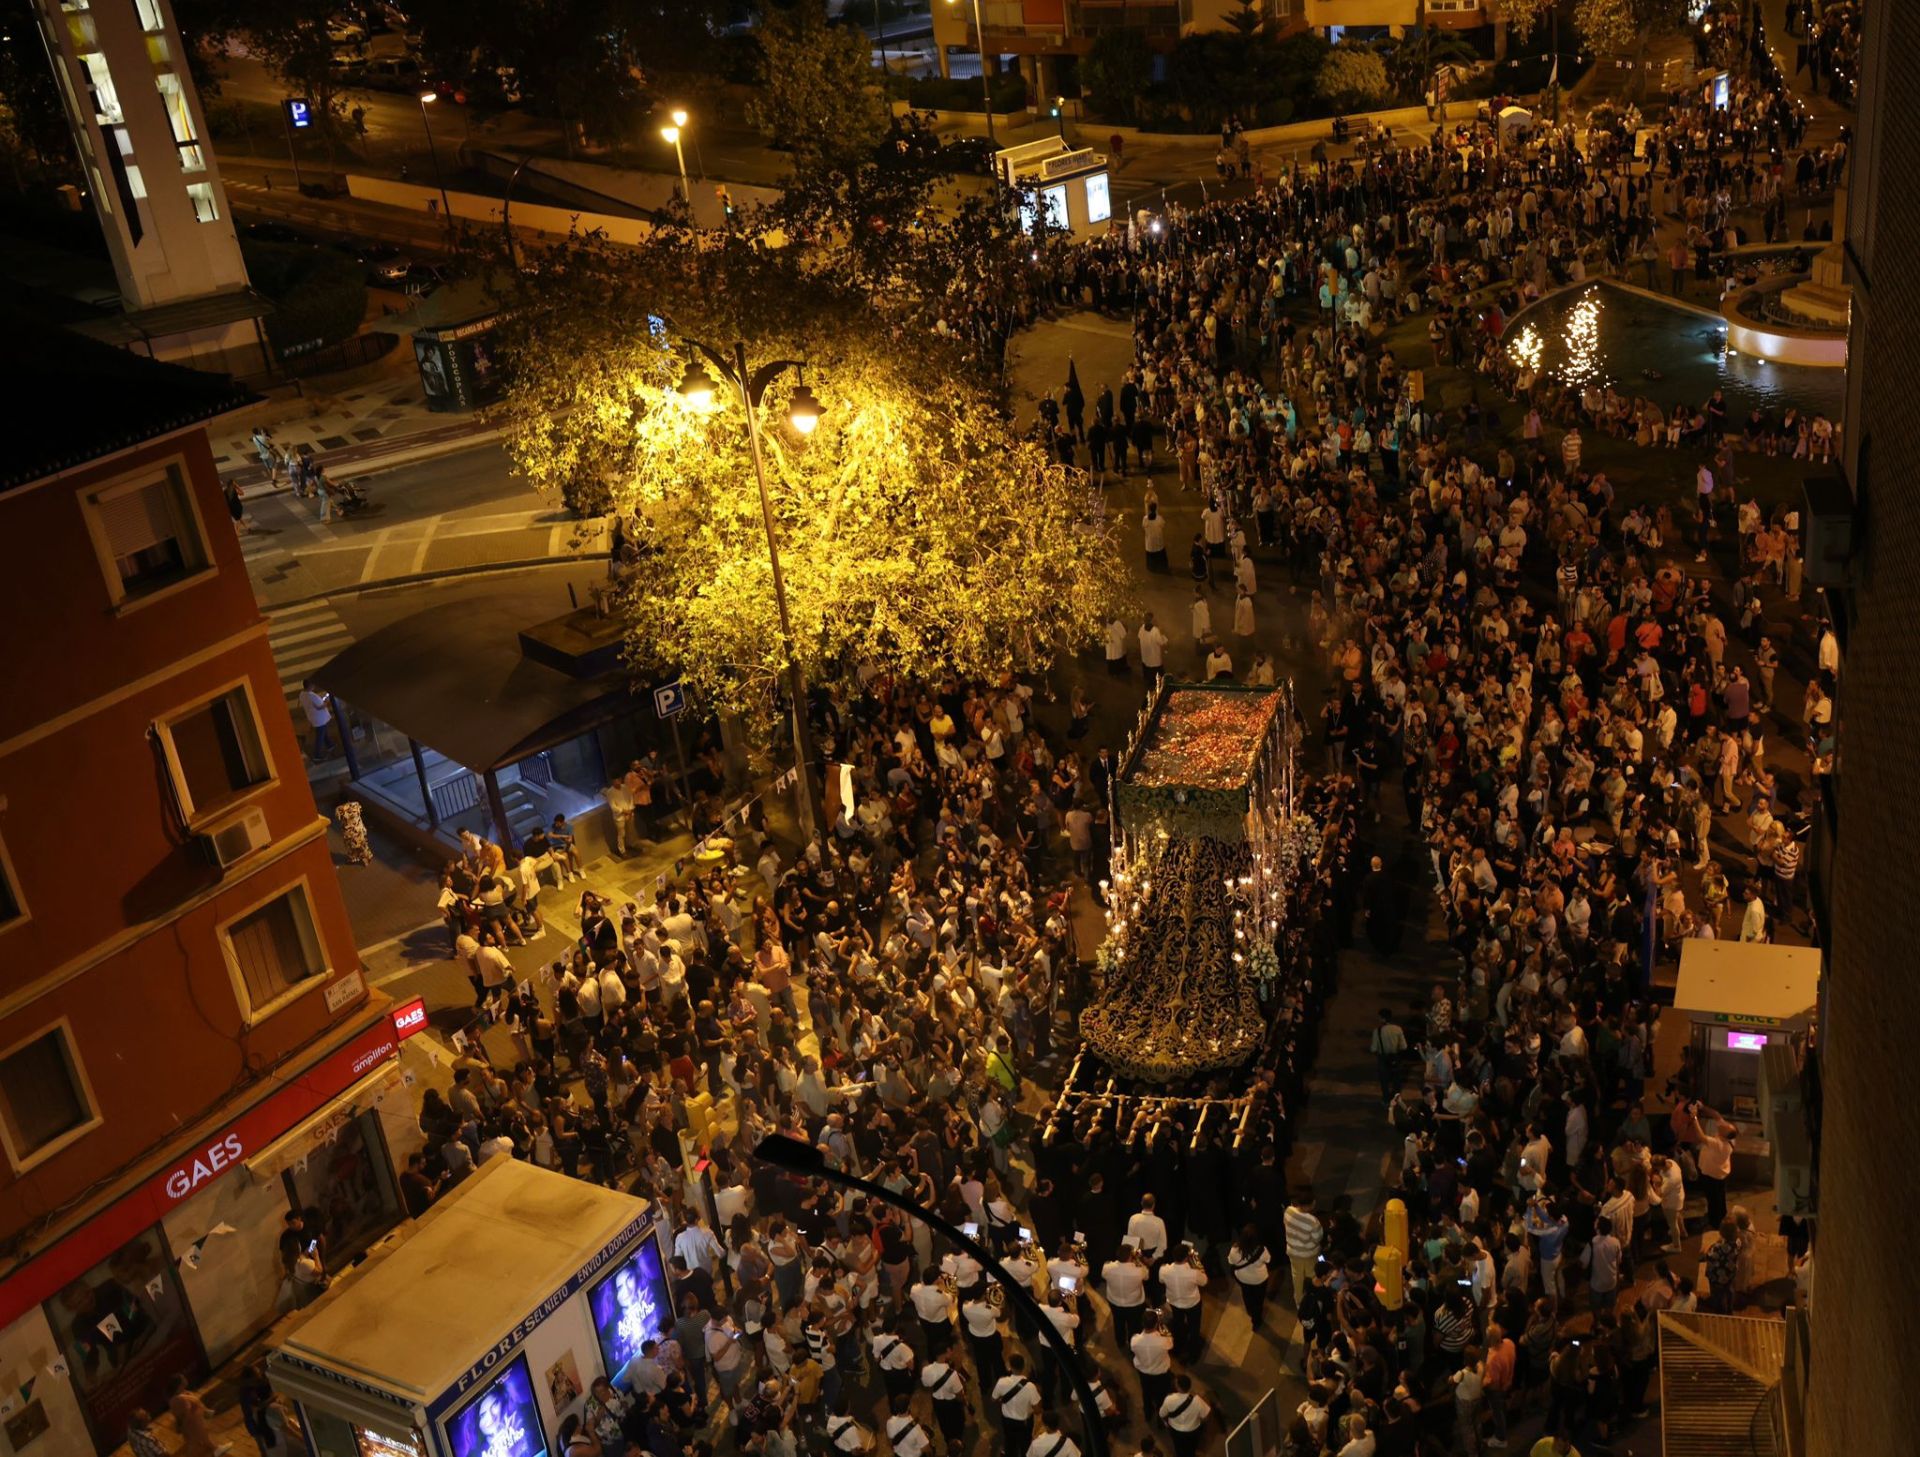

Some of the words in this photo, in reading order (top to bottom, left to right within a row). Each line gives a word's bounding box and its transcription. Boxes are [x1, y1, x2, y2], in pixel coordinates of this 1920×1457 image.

[291, 102, 306, 120] P
[395, 1007, 424, 1028] GAES
[353, 1042, 392, 1073] amplifon
[166, 1132, 243, 1199] GAES
[457, 1315, 536, 1393] FLORES
[534, 1310, 546, 1324] EL
[544, 1285, 569, 1313] NIETO
[576, 1256, 602, 1283] ENVIO
[602, 1249, 609, 1261] A
[608, 1213, 648, 1254] DOMICILIO
